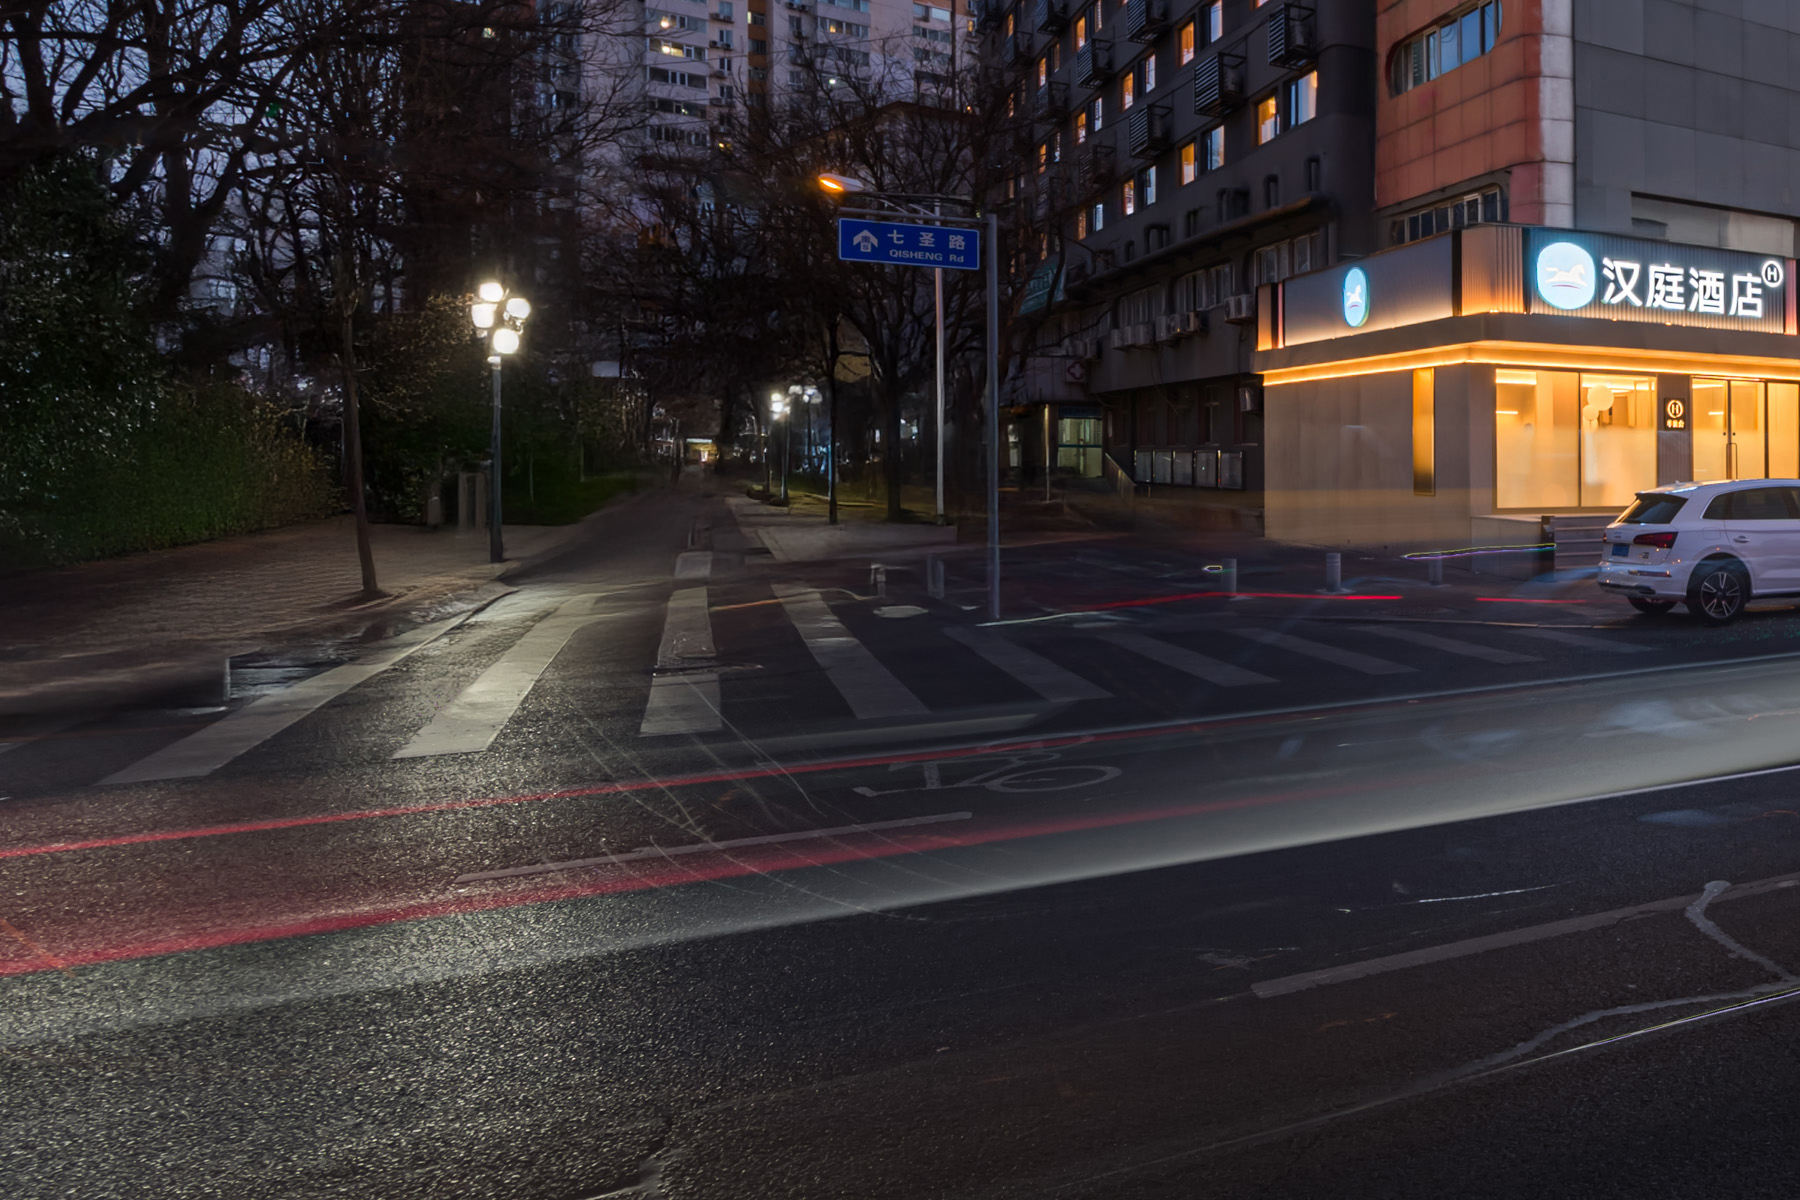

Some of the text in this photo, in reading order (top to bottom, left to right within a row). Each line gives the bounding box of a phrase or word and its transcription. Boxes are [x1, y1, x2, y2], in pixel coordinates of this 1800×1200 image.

[887, 229, 965, 250] 七圣路
[889, 249, 964, 263] QISHENG Rd
[1602, 257, 1762, 318] 汉庭酒店
